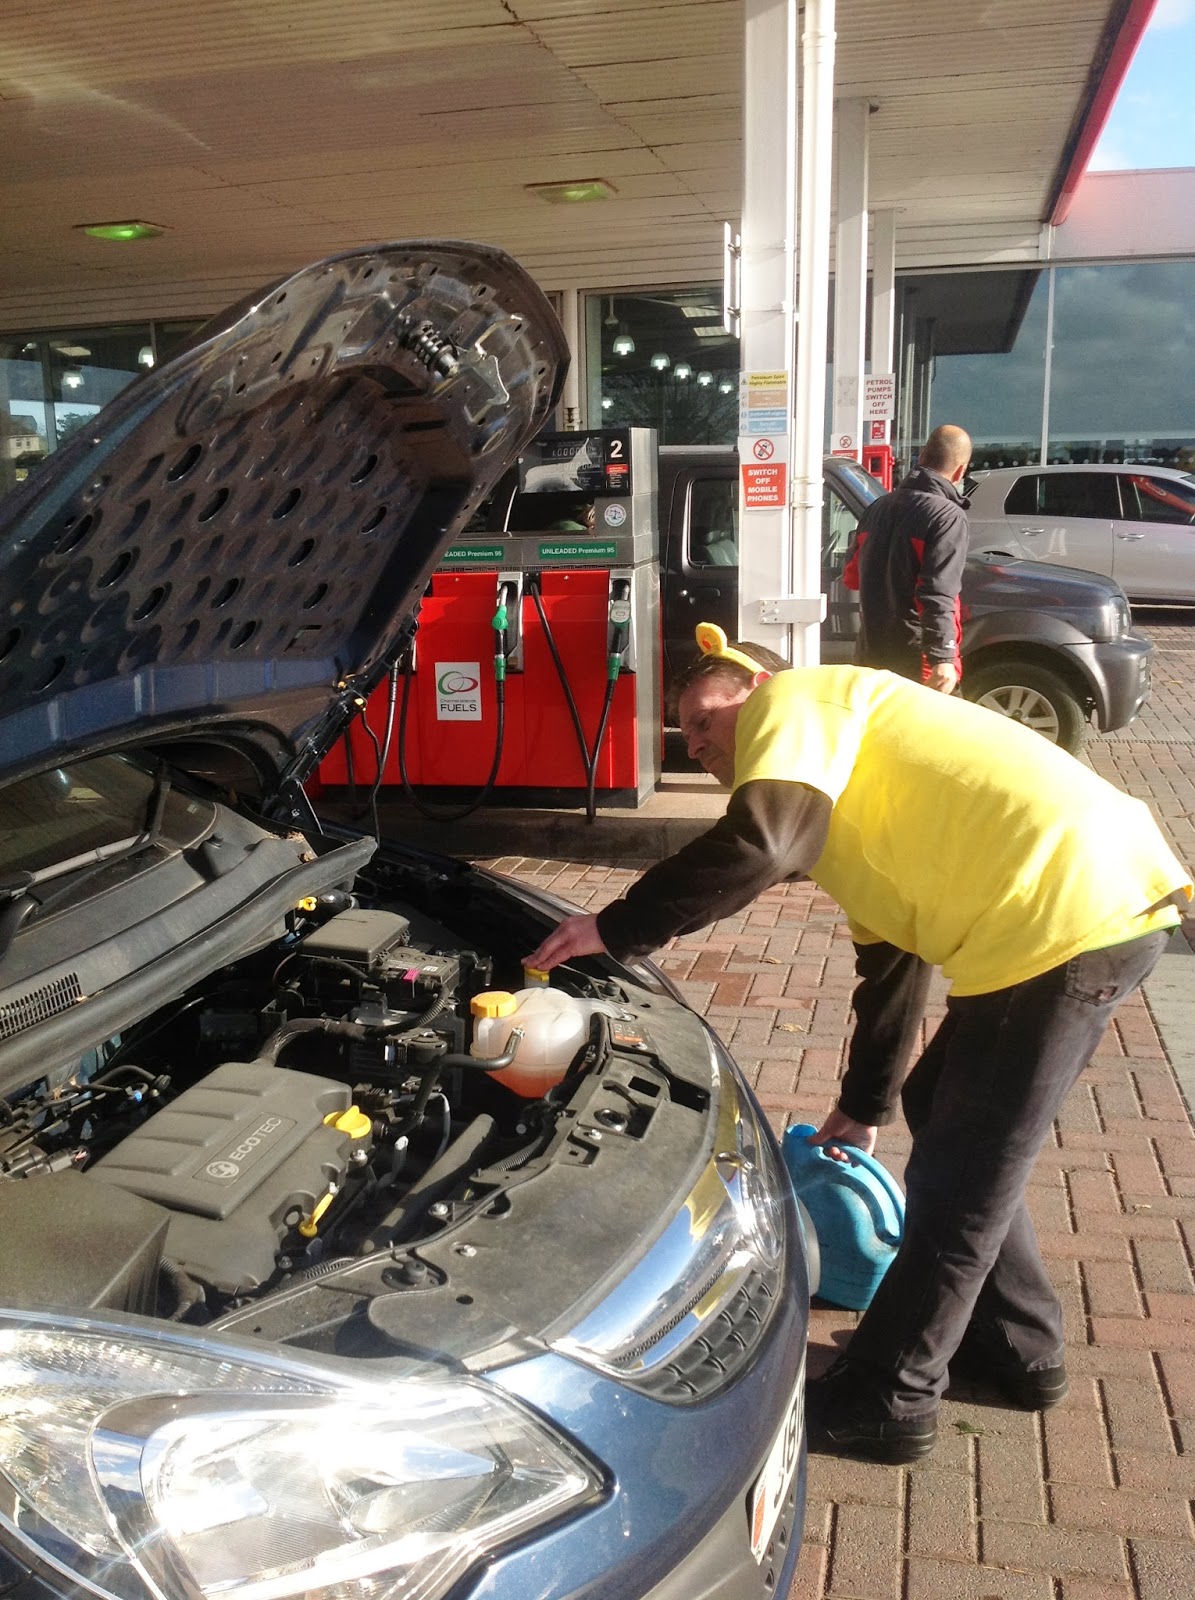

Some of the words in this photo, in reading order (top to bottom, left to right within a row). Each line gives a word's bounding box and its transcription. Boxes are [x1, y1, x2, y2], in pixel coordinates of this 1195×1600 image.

[610, 440, 623, 459] 2
[440, 704, 477, 712] FUELS
[229, 1117, 282, 1161] ECOTEC
